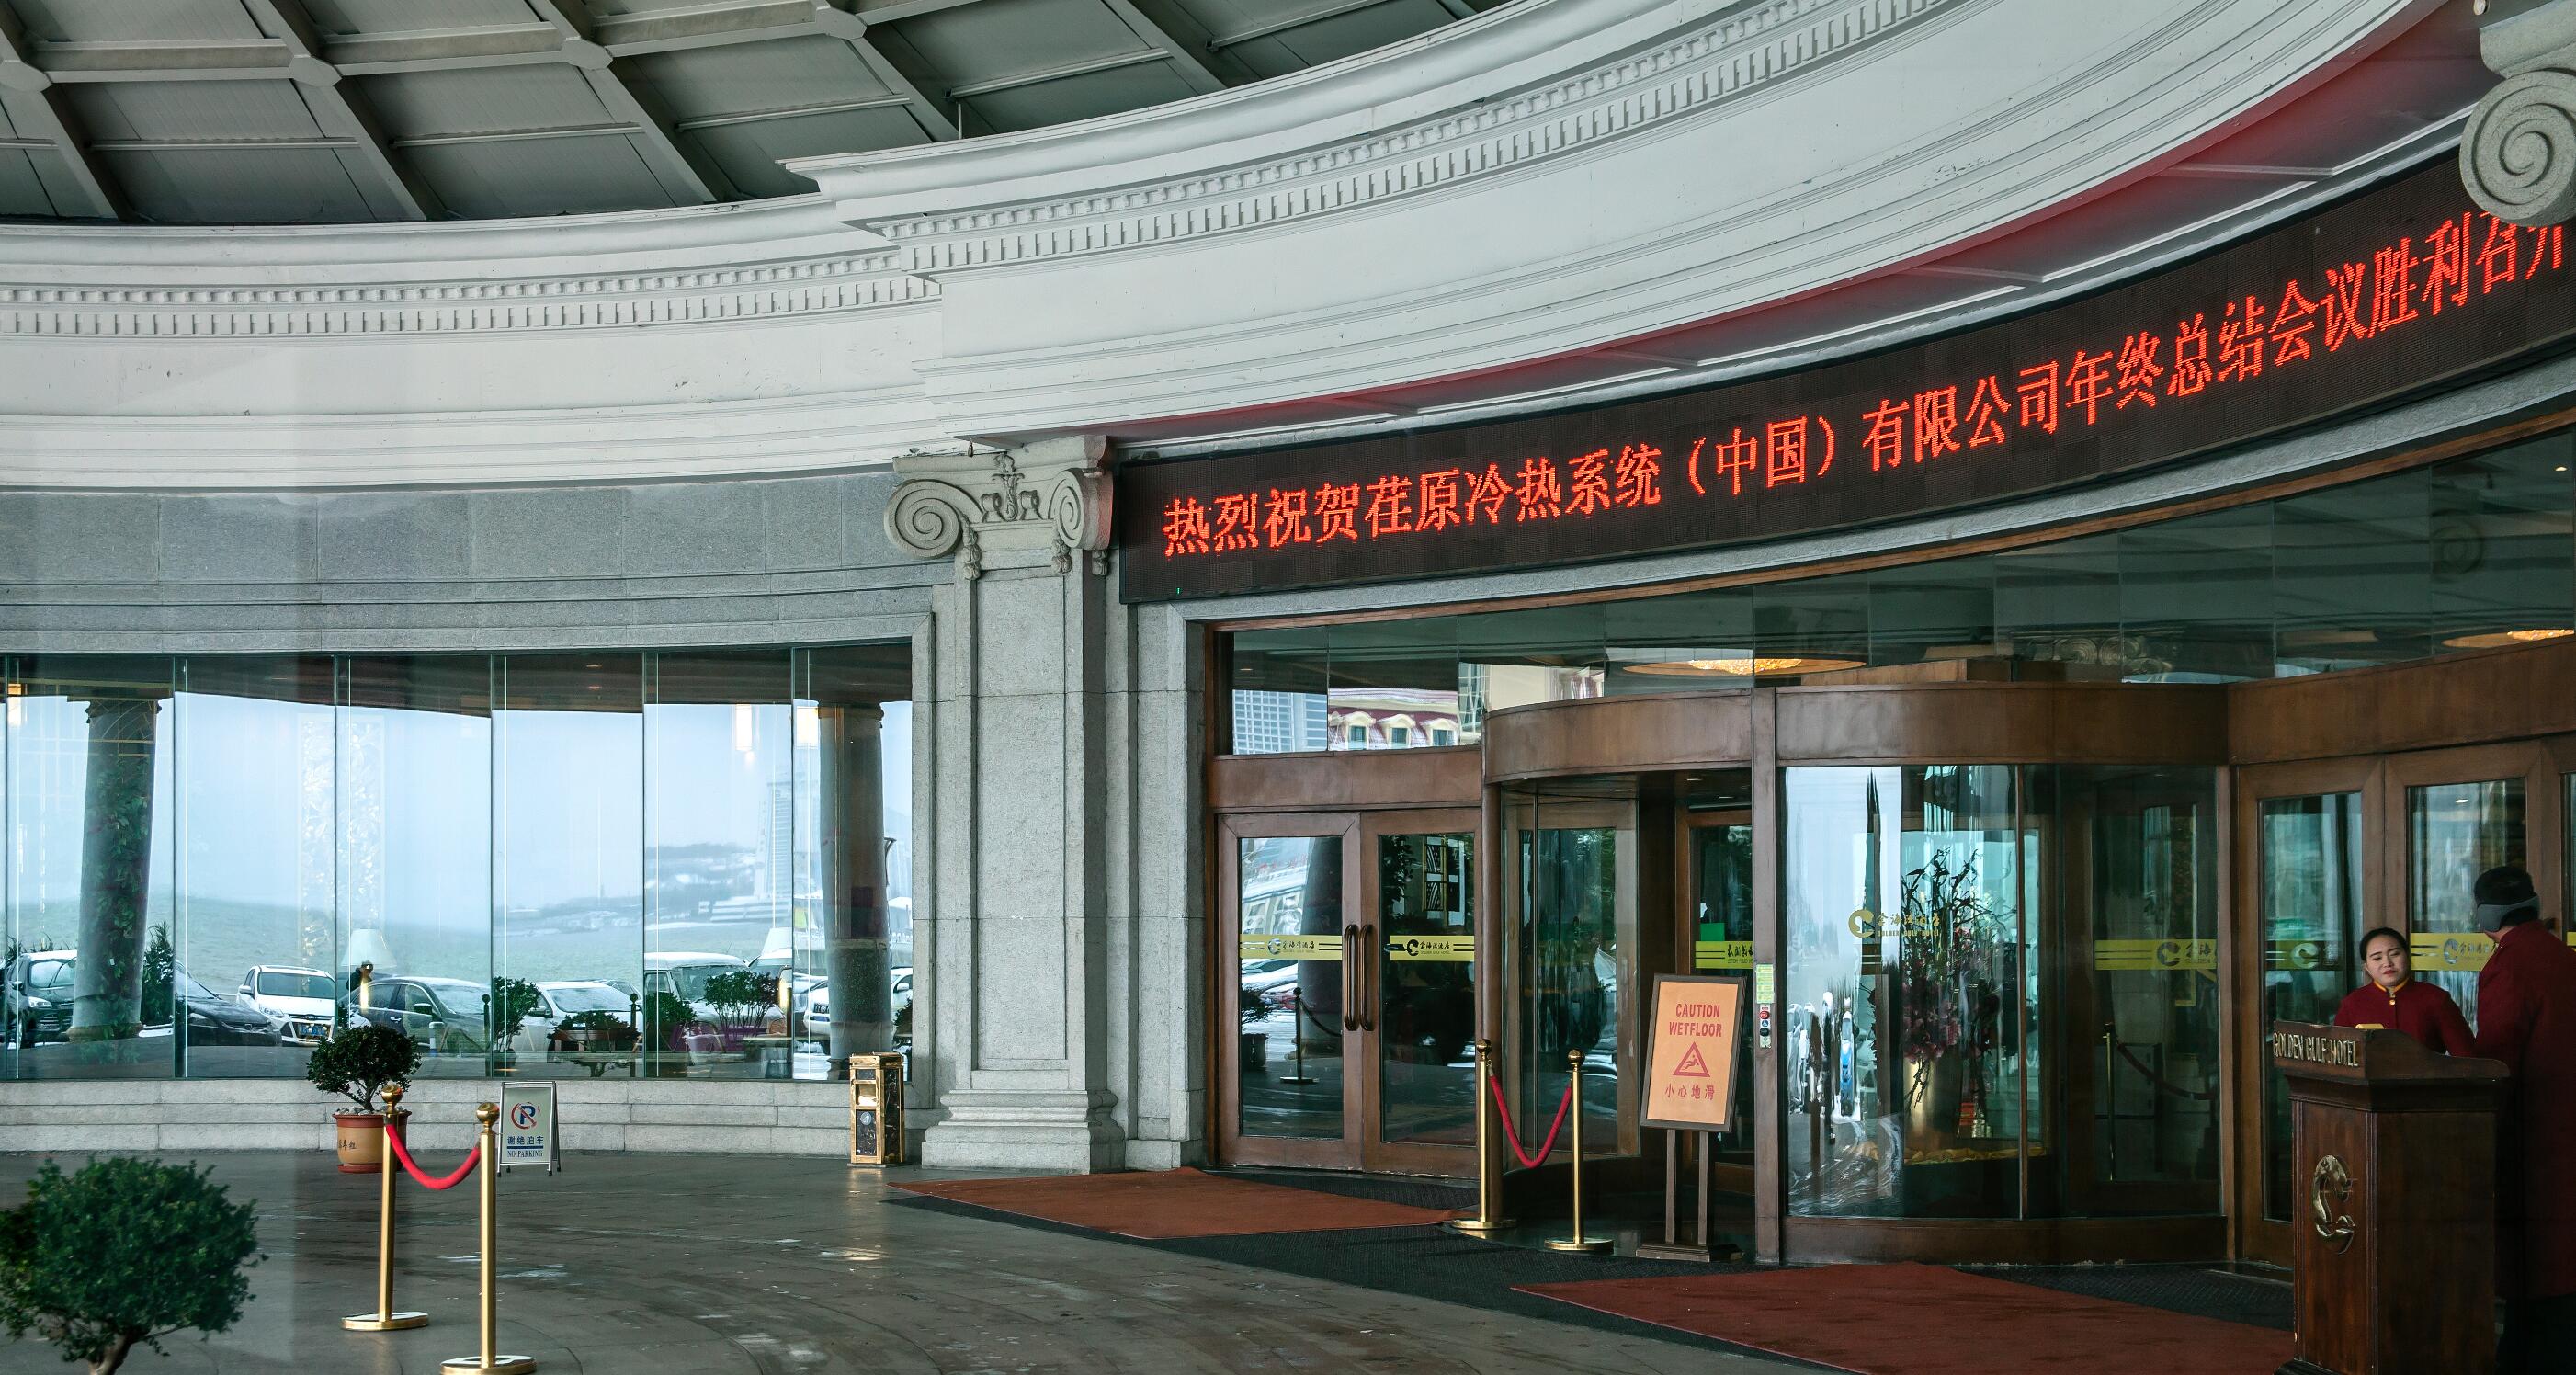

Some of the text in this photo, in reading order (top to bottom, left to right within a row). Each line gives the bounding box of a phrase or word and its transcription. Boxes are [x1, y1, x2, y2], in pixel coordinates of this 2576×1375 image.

[1675, 1003, 1721, 1018] CAUTION
[1669, 1021, 1722, 1038] WETFLOOR
[2273, 1031, 2359, 1067] GOLDEN GULF HOTEL
[1664, 1083, 1715, 1101] 小心地滑
[507, 1135, 544, 1145] 谢绝泊车
[507, 1150, 543, 1158] NO PARKING
